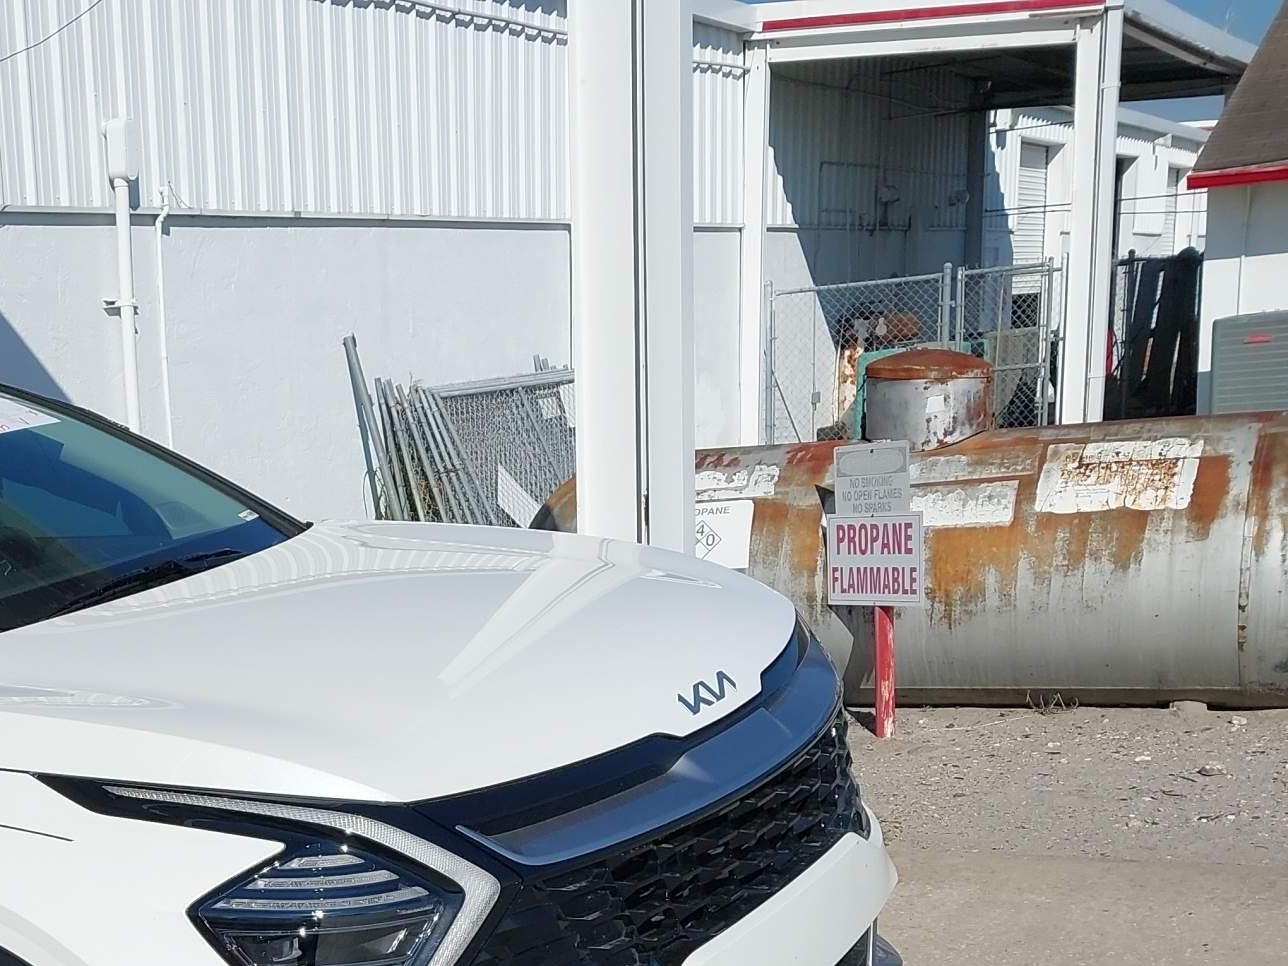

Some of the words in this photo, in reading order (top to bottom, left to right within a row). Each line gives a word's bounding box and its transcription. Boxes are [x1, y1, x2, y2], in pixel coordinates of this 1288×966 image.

[849, 479, 860, 488] NO
[842, 490, 853, 501] NO
[853, 490, 872, 501] OPEN
[874, 488, 903, 500] FLAMES
[852, 503, 862, 513] NO
[864, 502, 892, 513] SPARKS
[696, 524, 705, 537] 4
[836, 522, 913, 556] PROPANE
[832, 566, 918, 595] FLAMMABLE
[677, 670, 737, 715] KIA
